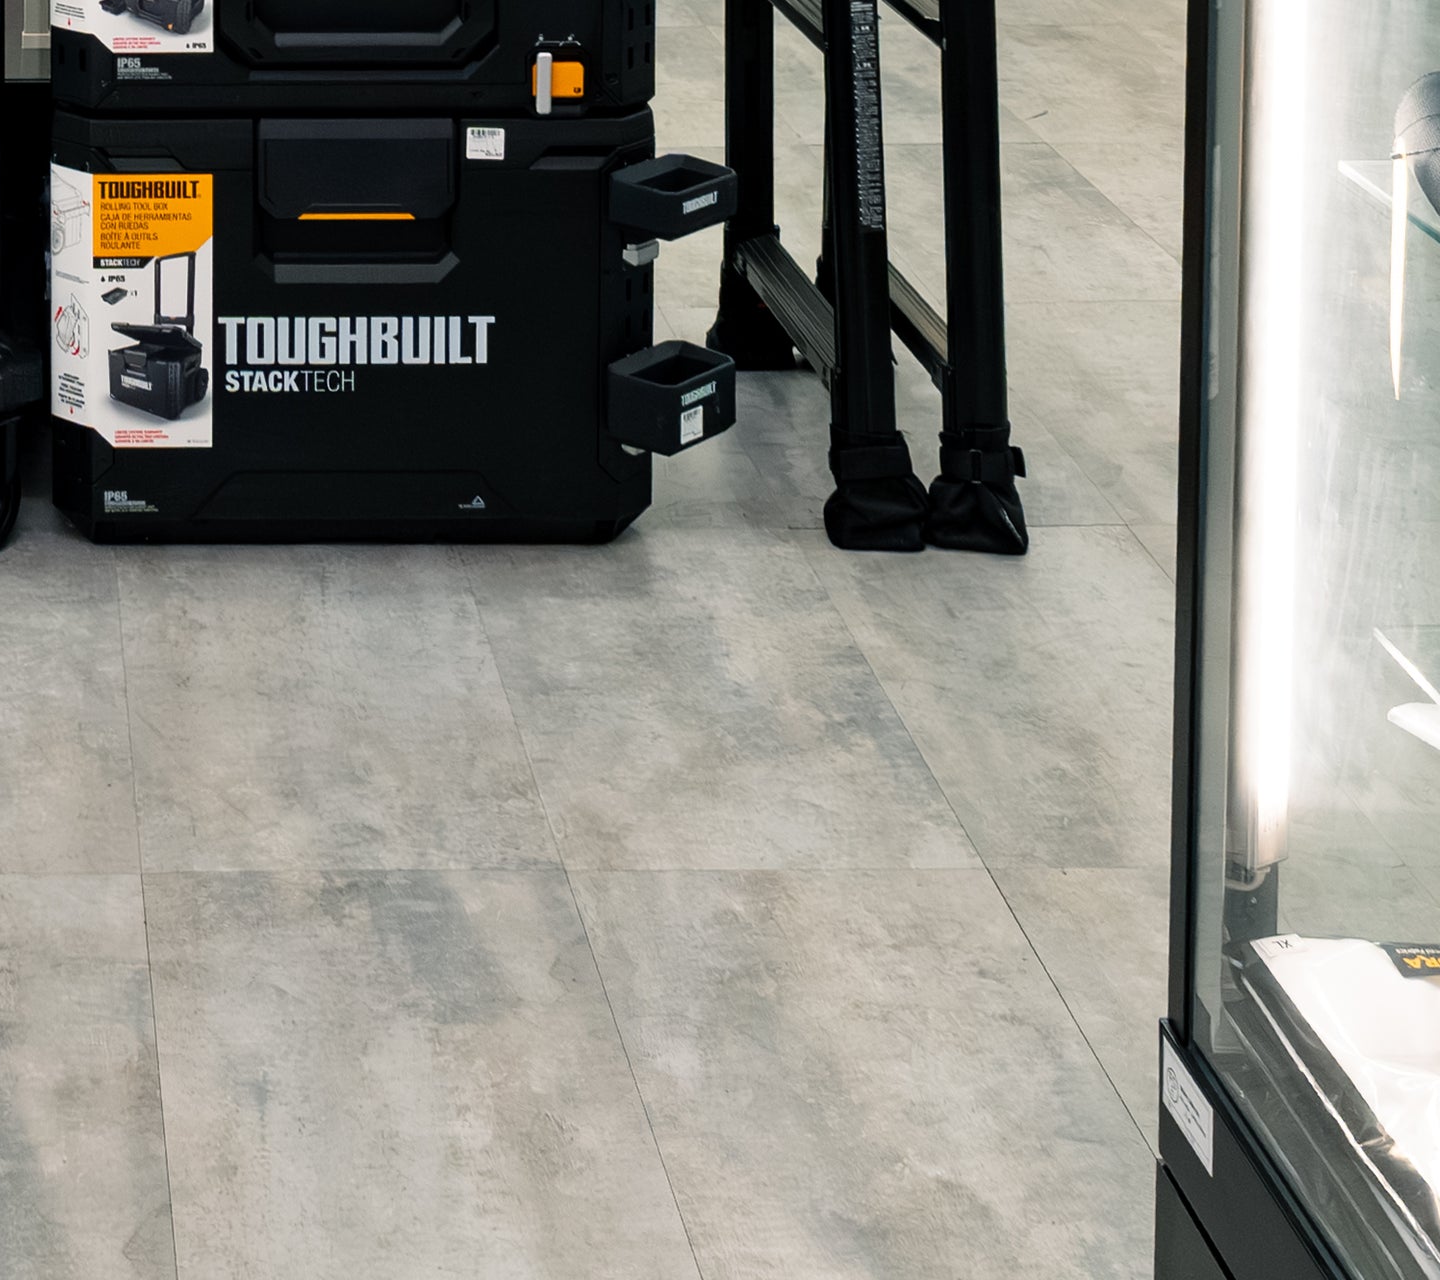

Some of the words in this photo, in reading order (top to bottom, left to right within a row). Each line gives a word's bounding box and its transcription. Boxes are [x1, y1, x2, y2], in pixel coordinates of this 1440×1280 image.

[117, 57, 142, 70] IP65
[97, 180, 200, 200] TOUGHBUILT
[100, 221, 117, 230] CON
[118, 221, 149, 230] RUEDAS
[100, 241, 141, 250] ROULANTE
[217, 314, 496, 367] TOUGHBUILT
[224, 368, 357, 395] STACKTECH
[103, 490, 129, 503] IP65
